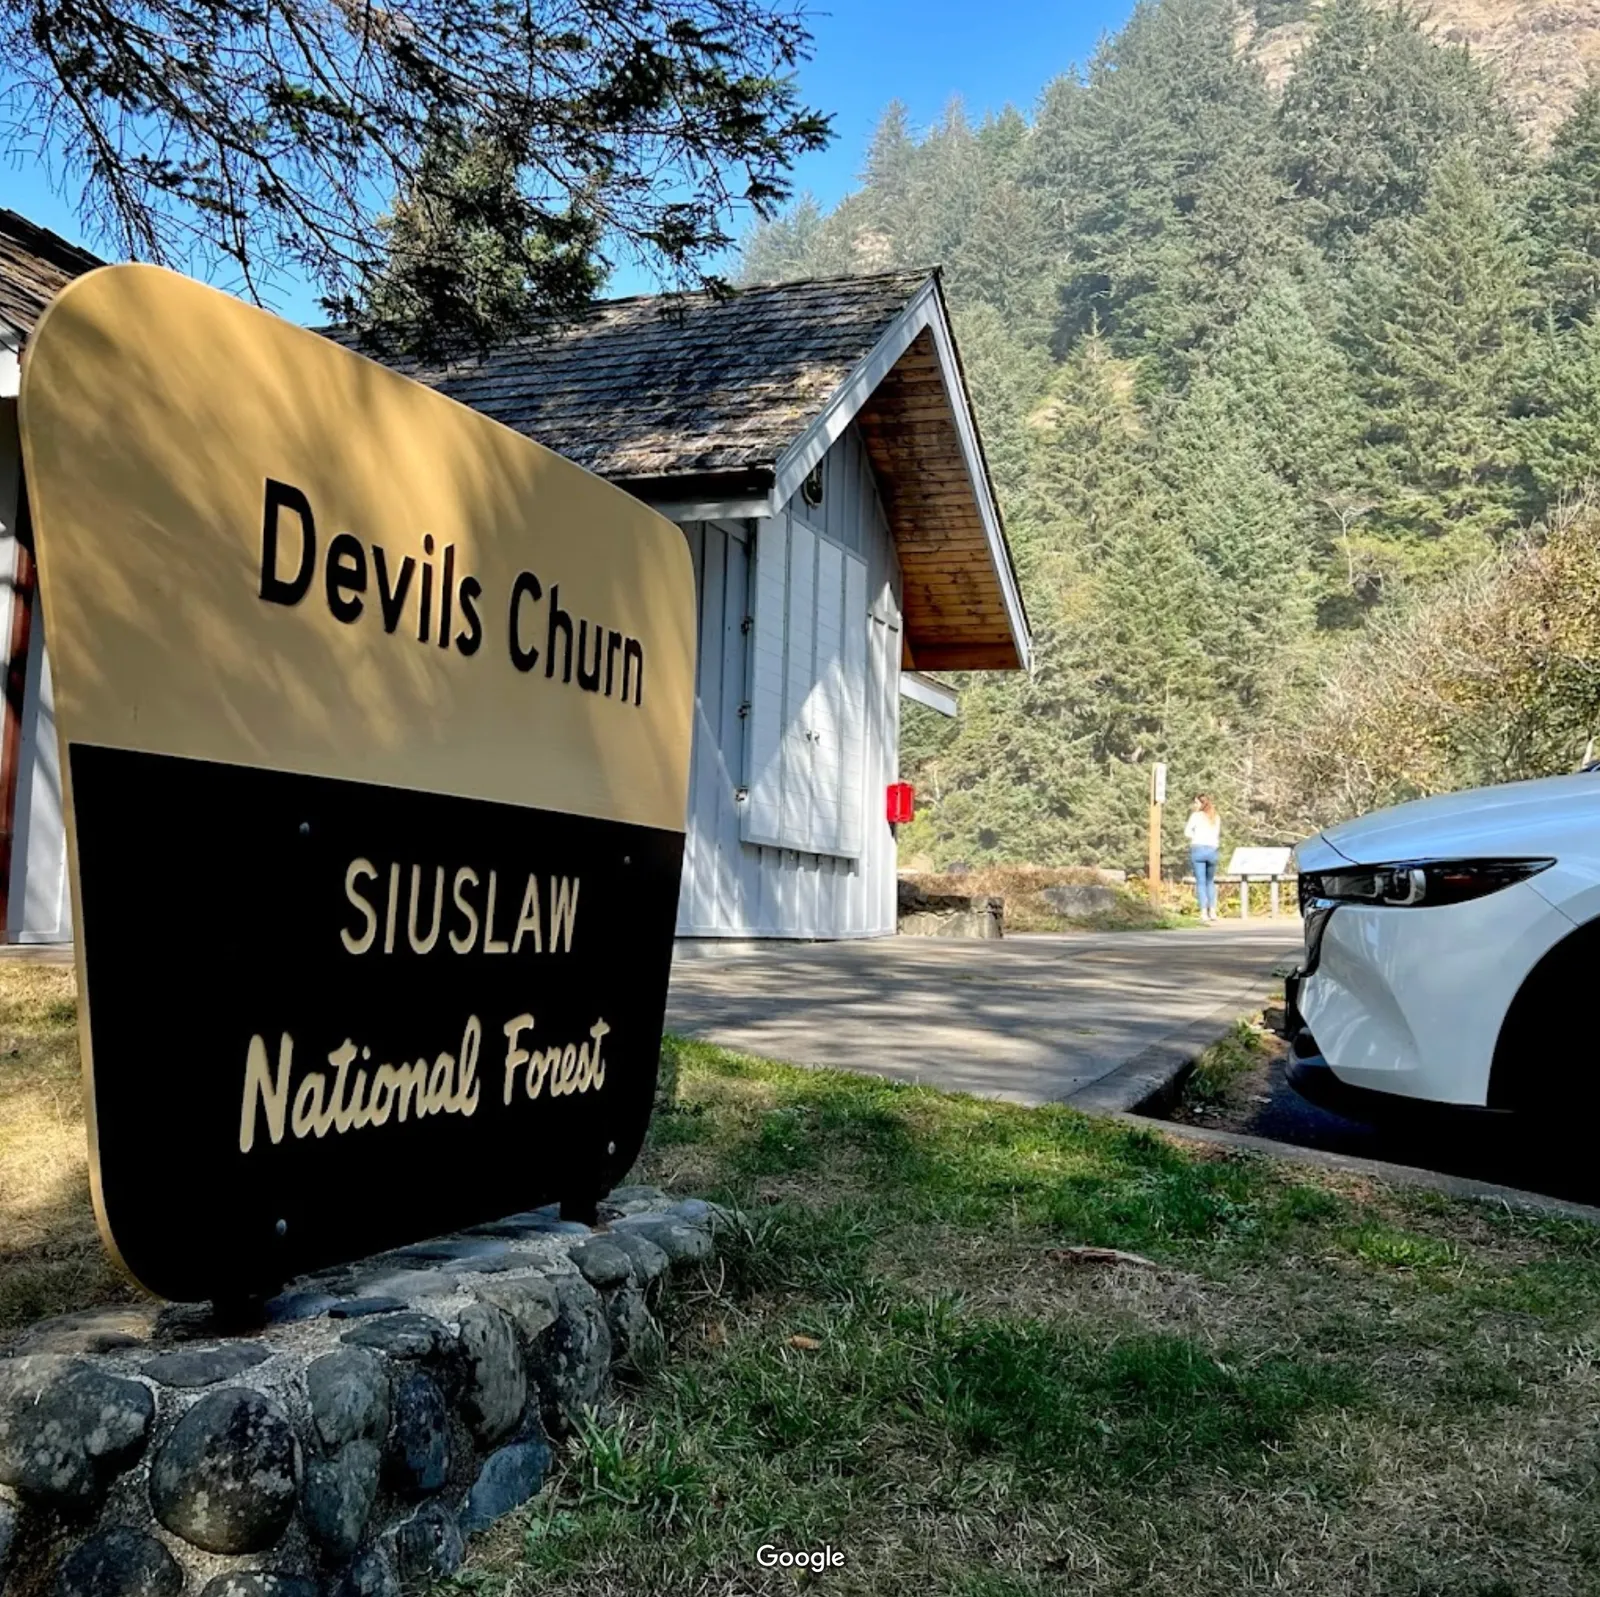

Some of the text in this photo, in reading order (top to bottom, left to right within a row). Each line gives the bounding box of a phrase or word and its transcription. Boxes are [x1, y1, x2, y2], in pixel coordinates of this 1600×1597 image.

[259, 477, 642, 706] Devils Churn
[340, 857, 580, 955] SIUSLAW
[239, 1013, 610, 1153] National Forest
